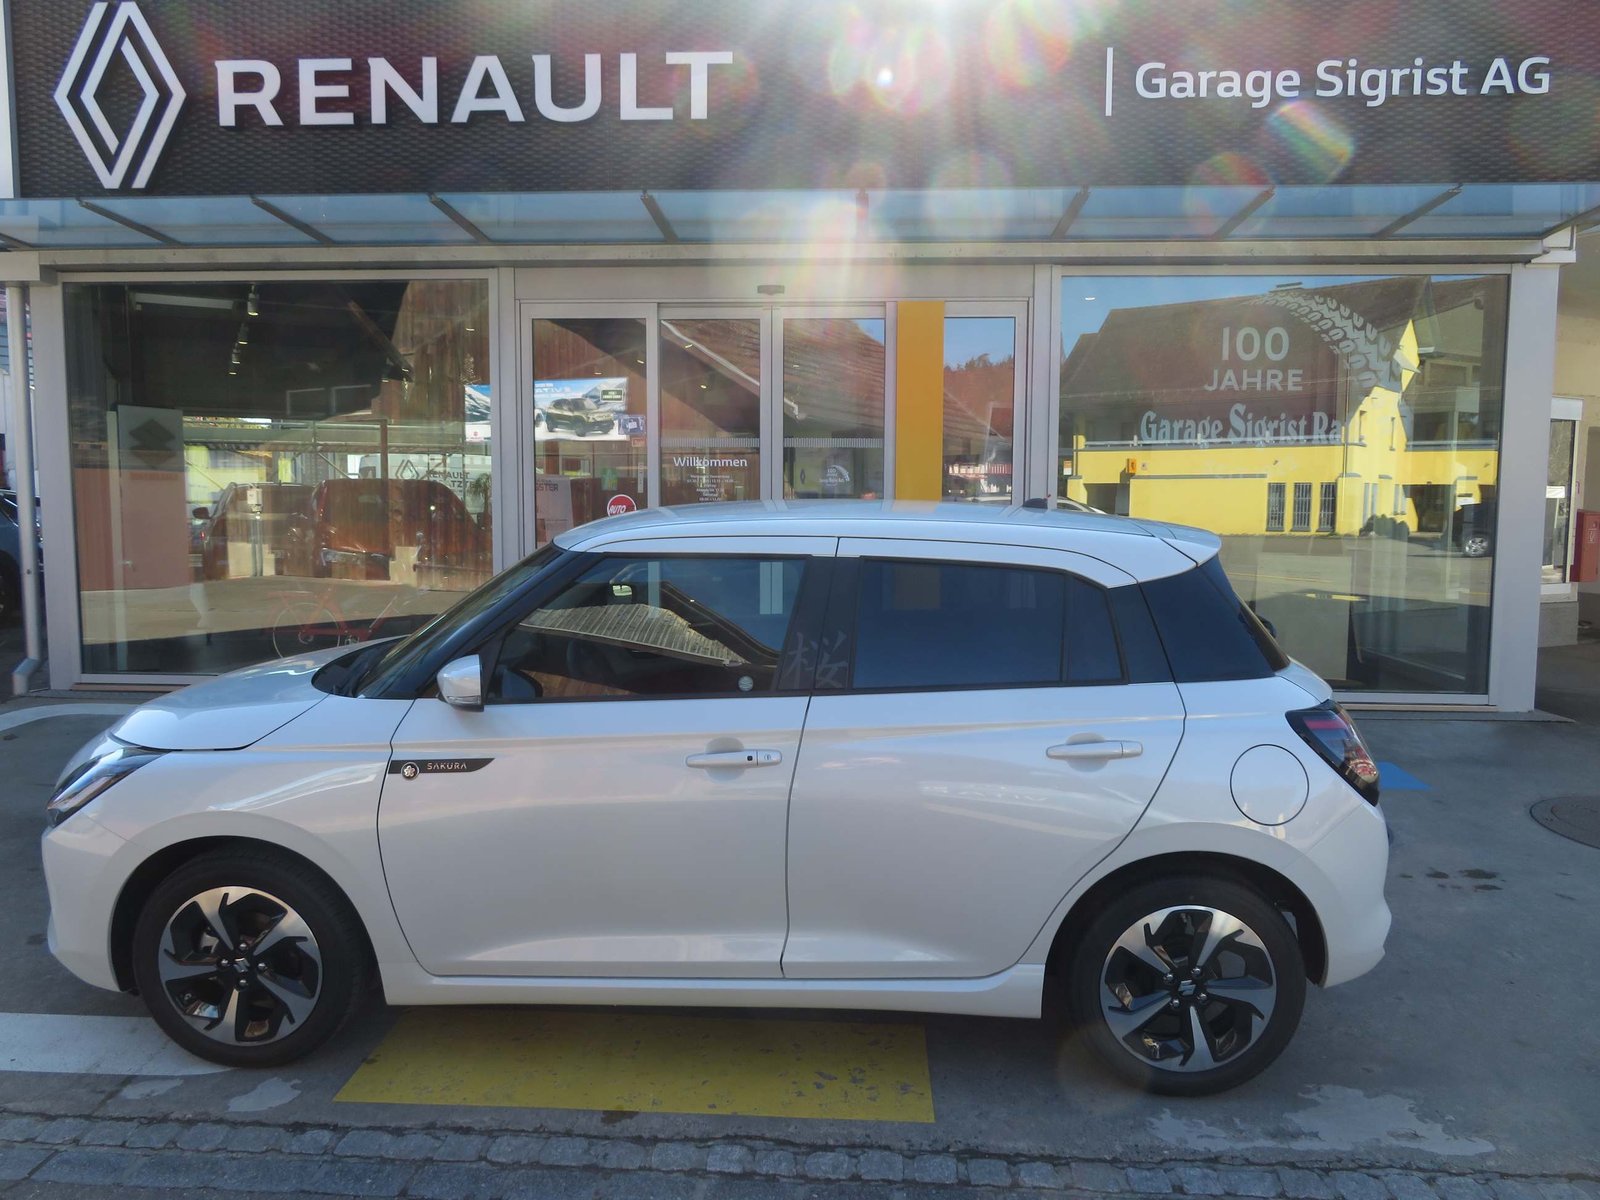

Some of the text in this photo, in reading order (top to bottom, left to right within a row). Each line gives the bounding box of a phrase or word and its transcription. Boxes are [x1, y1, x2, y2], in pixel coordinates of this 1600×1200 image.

[215, 51, 733, 127] RENAULT
[1135, 56, 1551, 109] Garage Sigrist AG
[1221, 326, 1290, 362] 100
[1203, 368, 1304, 392] JAHRE
[1140, 410, 1224, 449] Garage
[1227, 402, 1308, 449] Sigrist
[673, 456, 748, 467] Willkommen
[608, 504, 627, 514] AUTO
[426, 762, 468, 770] SAKURA
